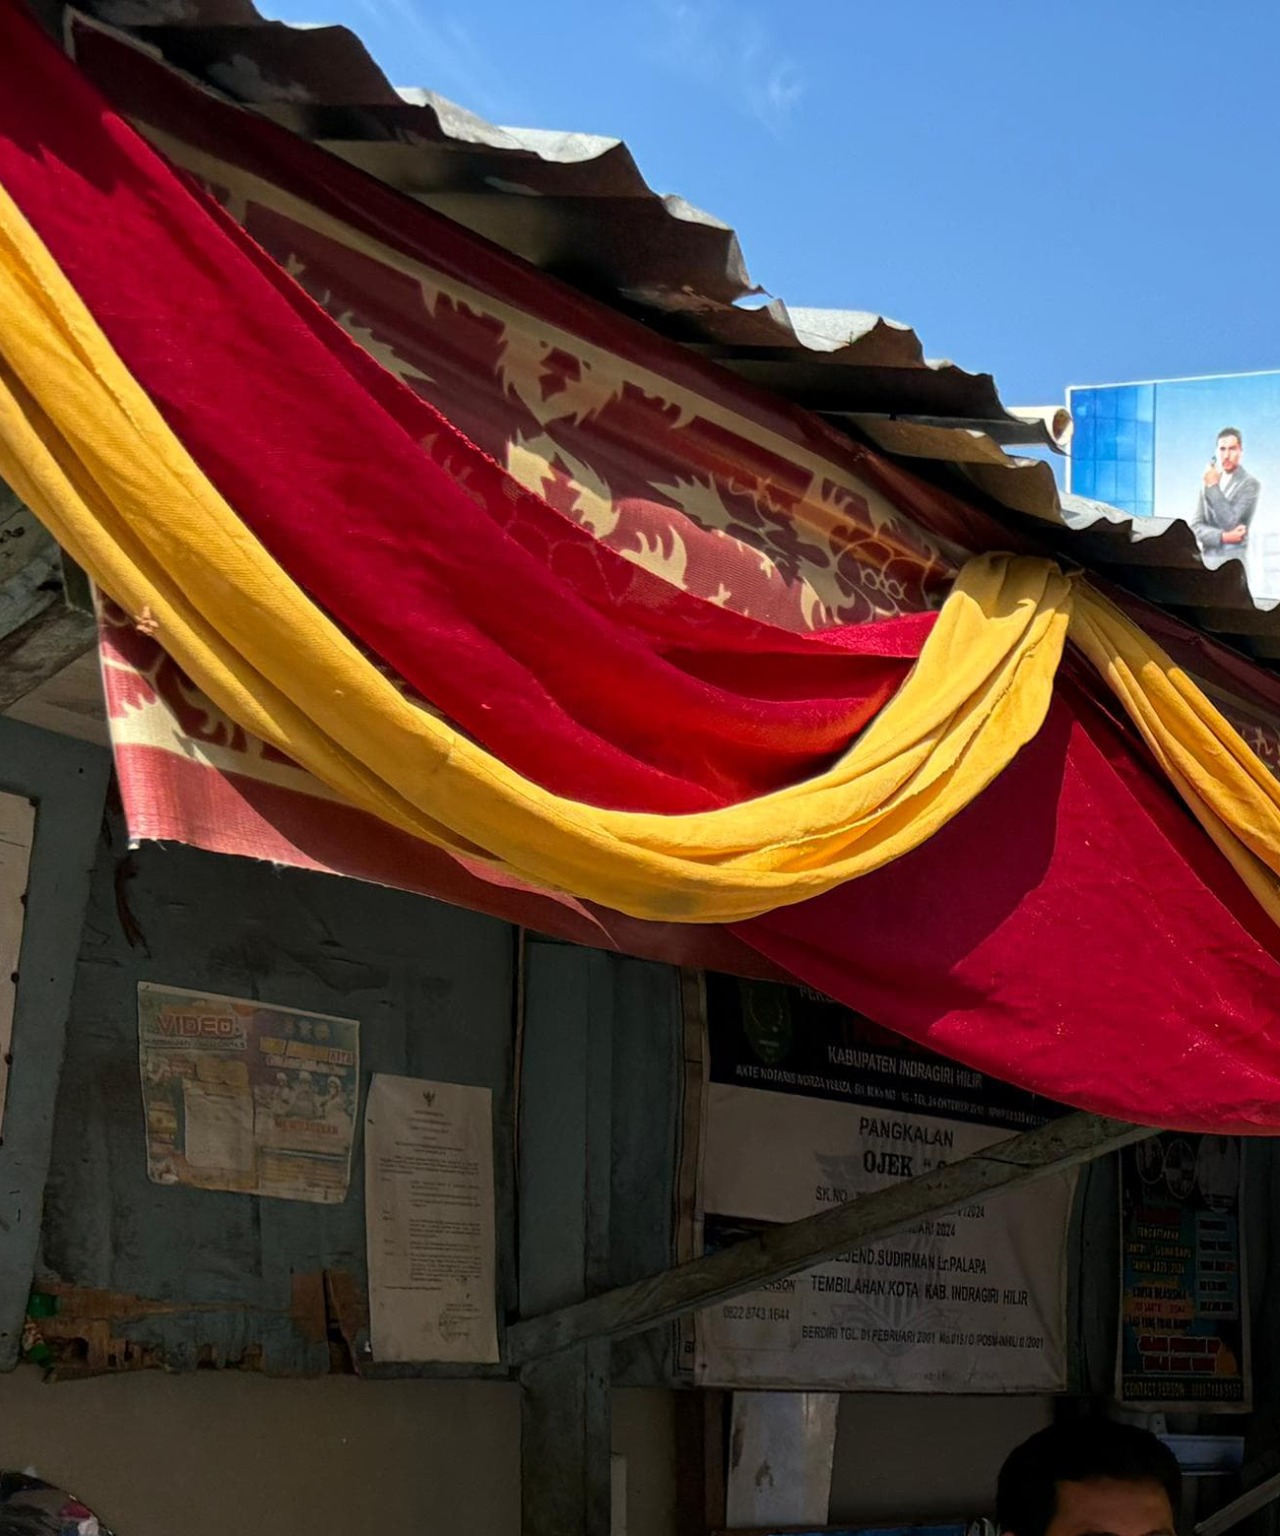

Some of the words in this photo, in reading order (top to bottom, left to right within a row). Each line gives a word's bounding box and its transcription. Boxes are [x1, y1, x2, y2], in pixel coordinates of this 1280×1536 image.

[827, 1045, 897, 1075] KABUPATEN
[899, 1058, 954, 1085] INDRAGIRI
[859, 1117, 954, 1148] PANGKALAN
[863, 1150, 913, 1177] OJEK
[811, 1275, 886, 1298] TEMBILAHAN
[889, 1281, 920, 1298] KOTA
[925, 1284, 949, 1301] KAB.
[951, 1286, 999, 1304] INDRAGIRI
[1003, 1289, 1029, 1307] HILIR
